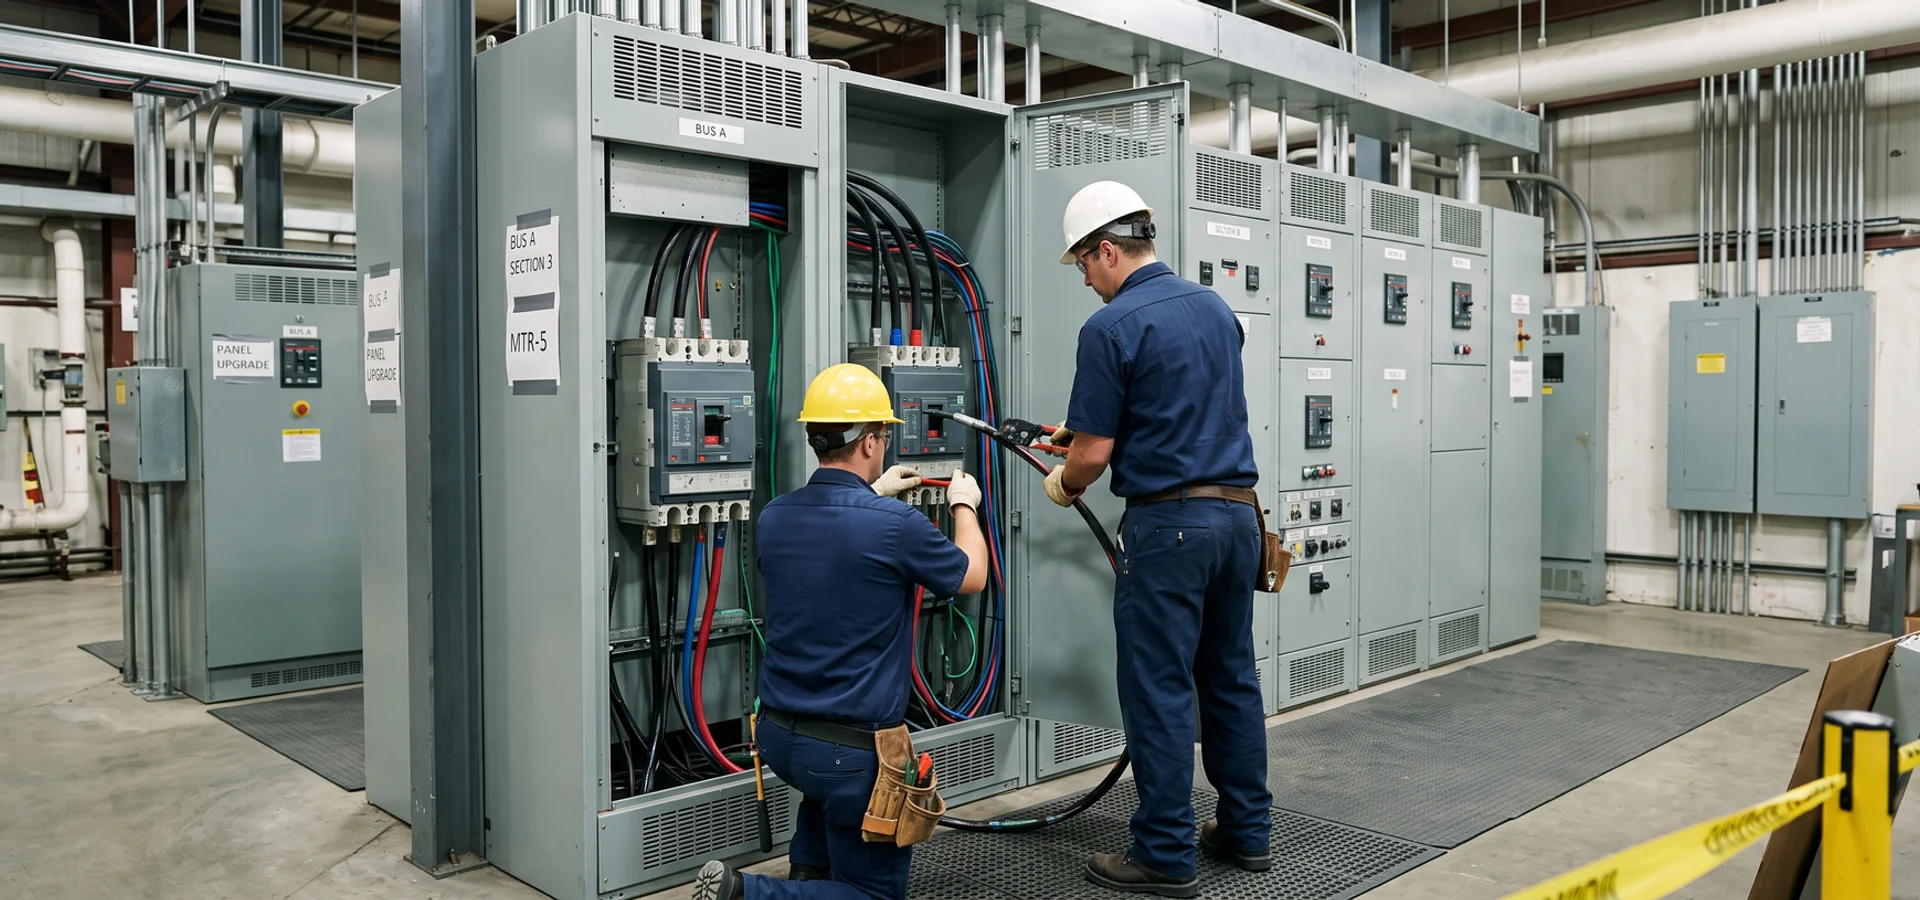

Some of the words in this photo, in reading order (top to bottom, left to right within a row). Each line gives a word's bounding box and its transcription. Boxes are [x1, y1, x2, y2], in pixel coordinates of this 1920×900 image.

[695, 123, 717, 137] BUS
[719, 127, 727, 138] A
[510, 233, 527, 250] BUS
[529, 231, 536, 247] A
[509, 256, 545, 275] SECTION
[547, 254, 553, 270] 3
[368, 292, 381, 308] BUS
[383, 290, 388, 303] A
[510, 330, 547, 353] MTR-5
[217, 345, 252, 355] PANEL
[366, 347, 386, 361] PANEL
[217, 360, 270, 369] UPGRADE
[366, 367, 397, 381] UPGRADE
